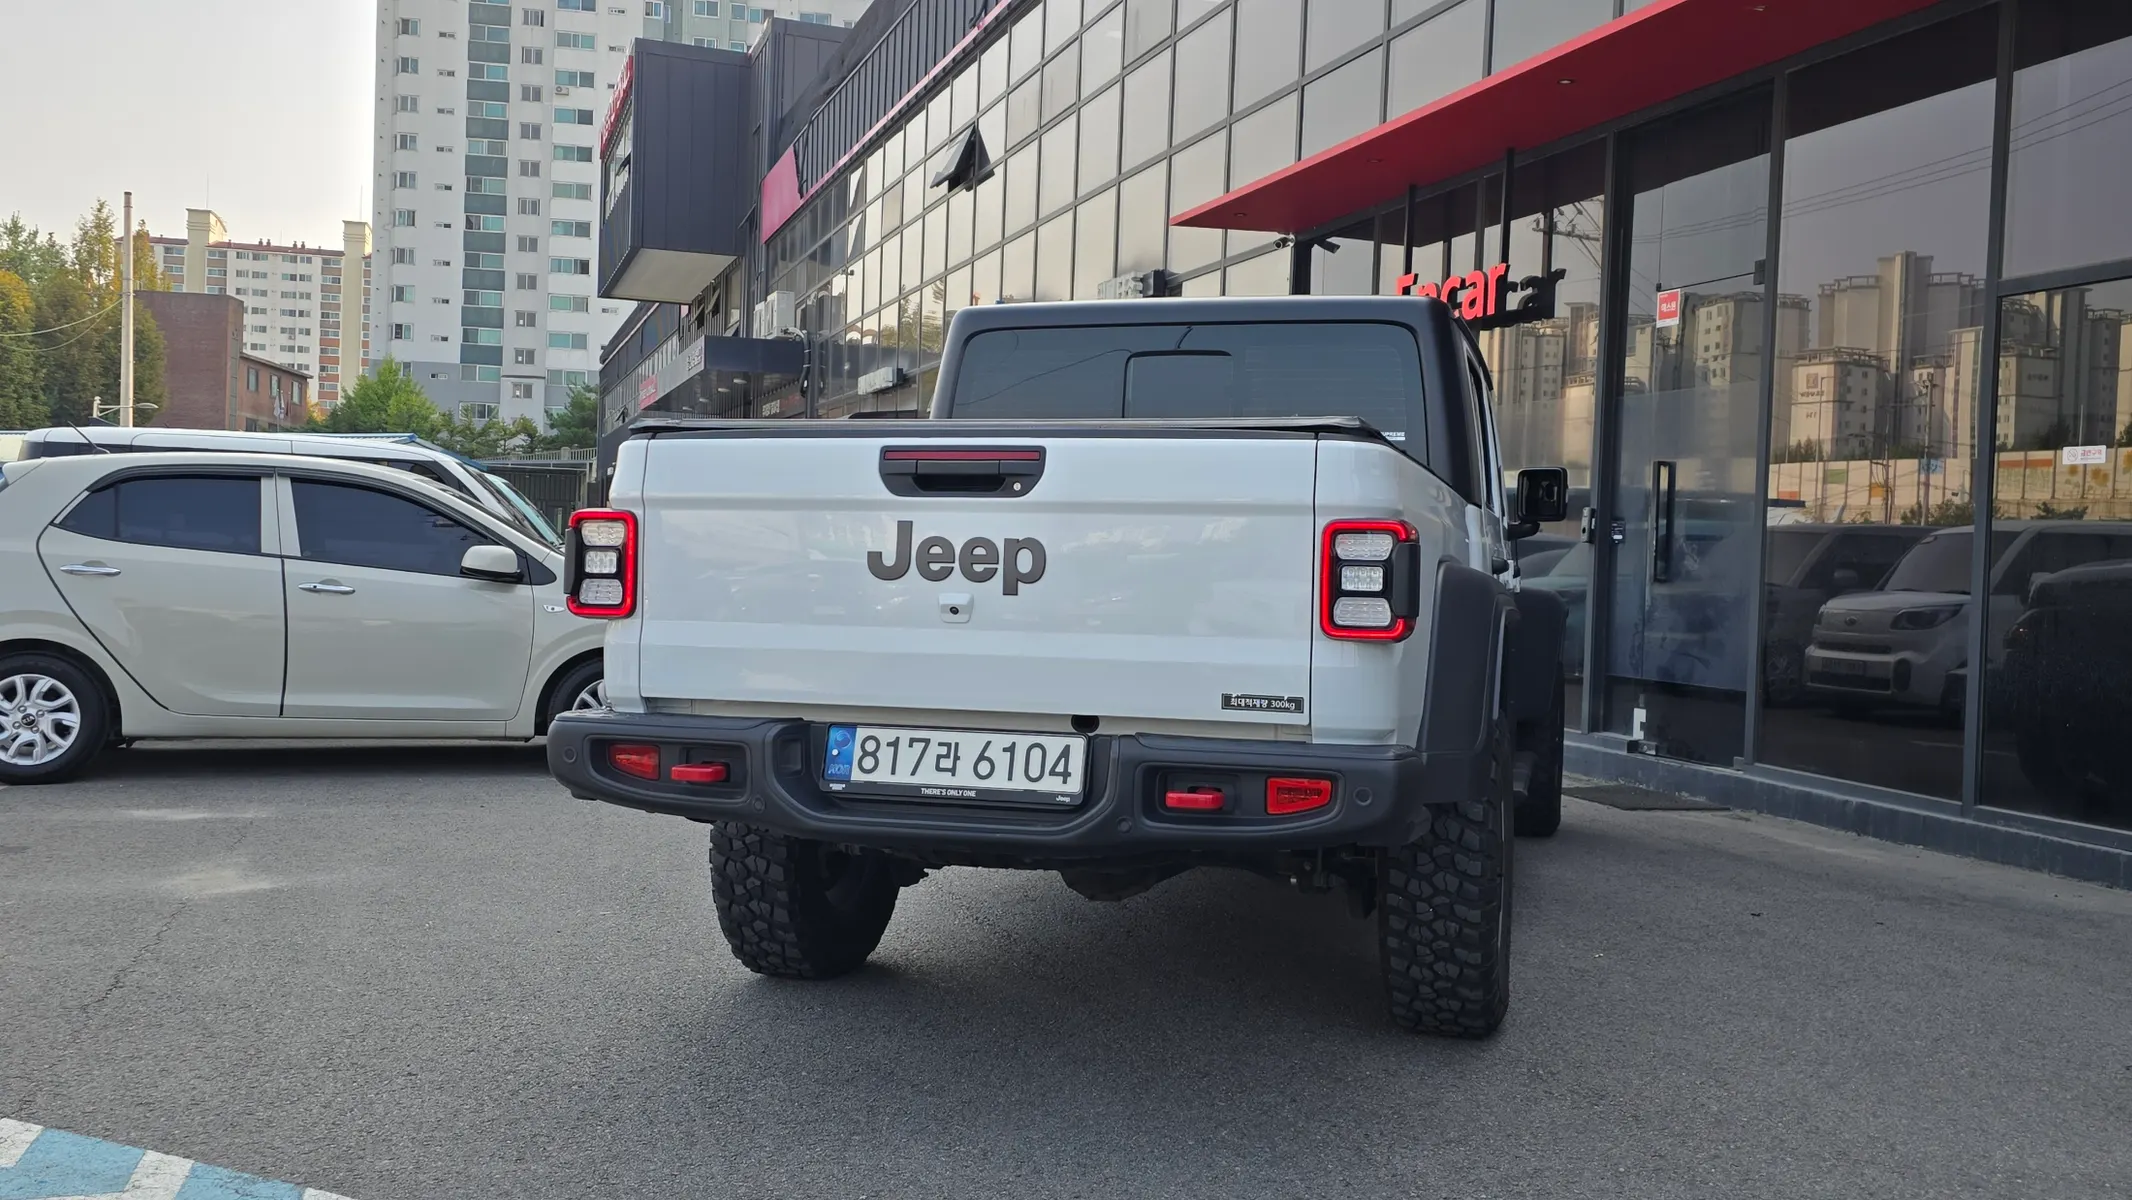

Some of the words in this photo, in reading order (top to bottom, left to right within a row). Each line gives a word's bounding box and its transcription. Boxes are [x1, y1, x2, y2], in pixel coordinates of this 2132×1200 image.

[867, 520, 1047, 596] Jeep
[1270, 700, 1295, 711] 300kg
[857, 735, 960, 777] 817라
[973, 740, 1071, 784] 6104
[921, 787, 946, 796] THERE'S
[947, 789, 964, 797] ONLY
[1056, 795, 1071, 803] Jeep
